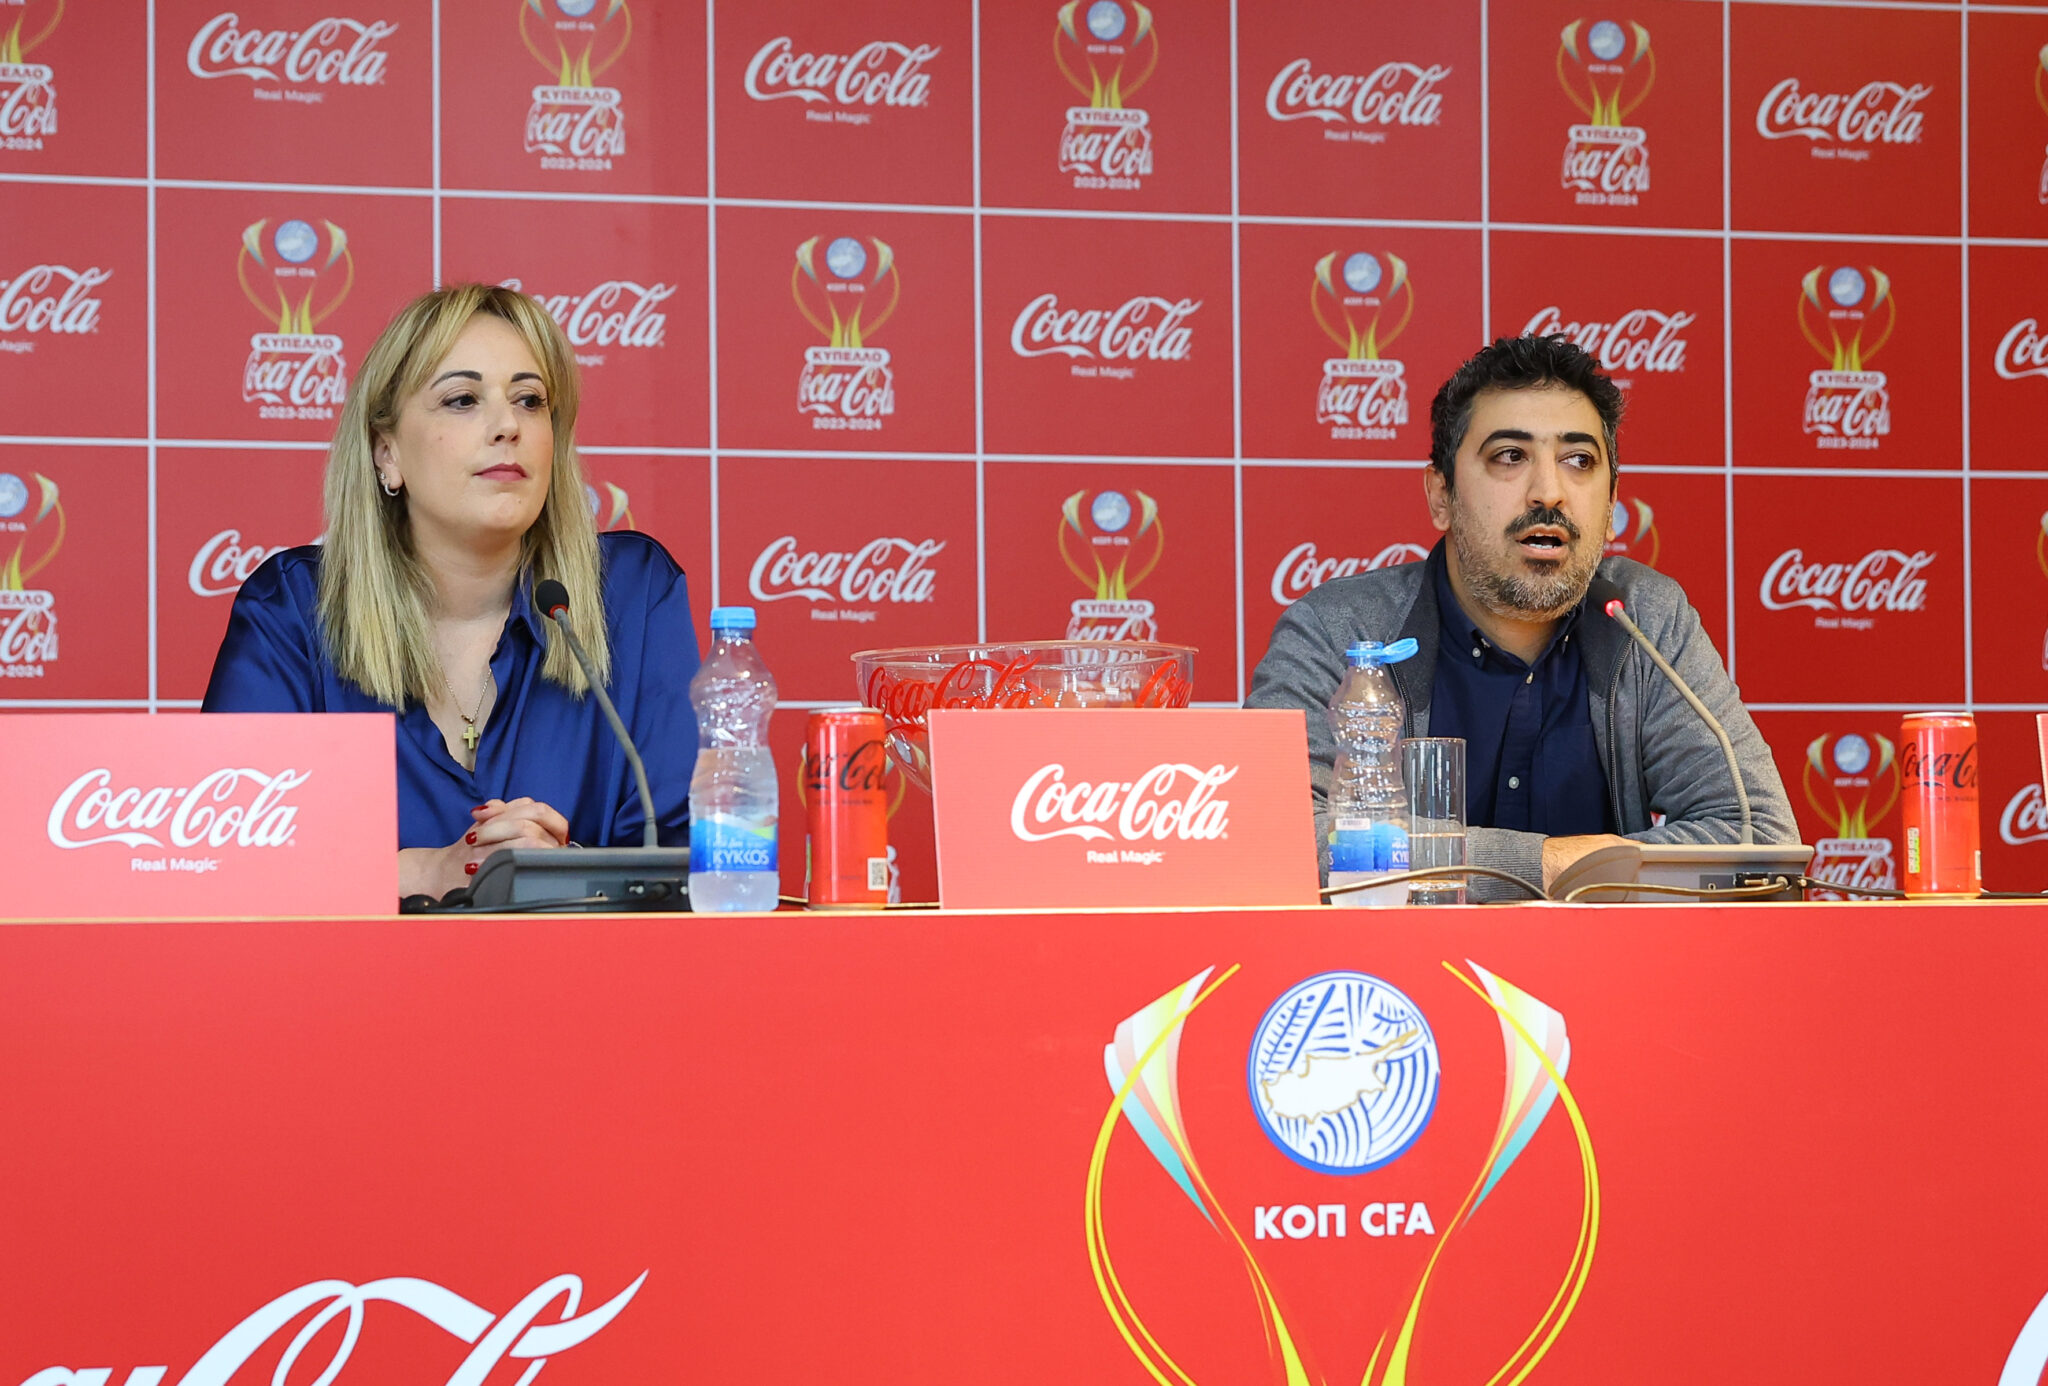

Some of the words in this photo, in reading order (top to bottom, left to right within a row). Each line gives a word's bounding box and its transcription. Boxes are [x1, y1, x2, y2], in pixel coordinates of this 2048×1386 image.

[188, 13, 398, 85] Coca-Cola
[2, 67, 43, 78] ΕΛΛΟ
[745, 37, 939, 106] Coca-Cola
[254, 88, 282, 100] Real
[285, 90, 322, 103] Magic
[1266, 59, 1451, 125] Coca-Cola
[806, 110, 833, 122] Real
[835, 112, 871, 125] Magic
[1757, 78, 1932, 143] Coca-Cola
[0, 138, 43, 150] -2024
[1325, 130, 1350, 141] Real
[1352, 131, 1384, 144] Magic
[0, 265, 113, 333] -Cola
[1011, 294, 1202, 360] Coca-Cola
[1071, 365, 1097, 376] Real
[1099, 367, 1134, 379] Magic
[259, 405, 333, 419] 2023-2024
[813, 417, 882, 430] 2023-2024
[749, 536, 946, 603] Coca-Cola
[1760, 549, 1936, 611] Coca-Cola
[2, 594, 44, 605] ΕΛΛΟ
[811, 609, 838, 620] Real
[840, 610, 875, 622] Magic
[0, 665, 44, 677] -2024
[48, 768, 312, 849] Coca-Cola
[1011, 764, 1239, 841] Coca-Cola
[1087, 850, 1119, 864] Real
[1121, 850, 1163, 865] Magic
[131, 858, 167, 871] Real
[170, 858, 218, 873] Magic
[1360, 1202, 1435, 1237] CFA
